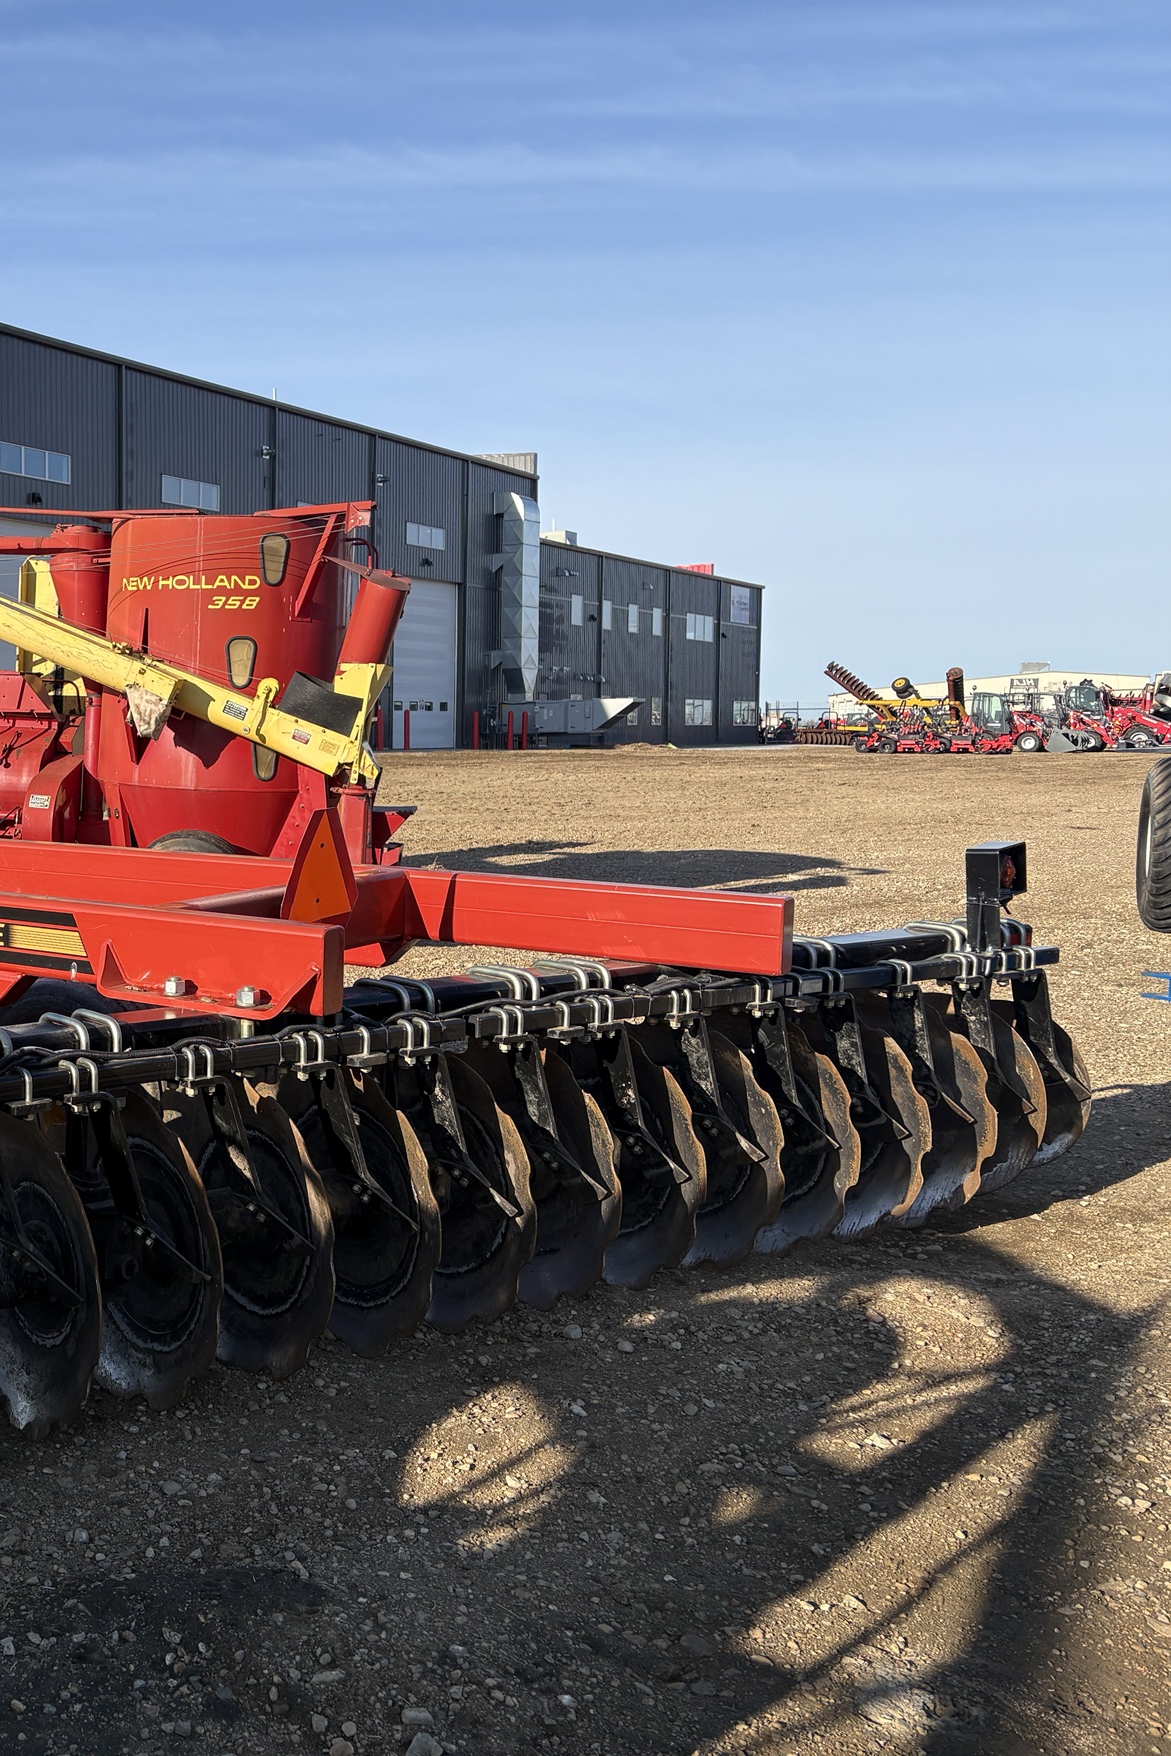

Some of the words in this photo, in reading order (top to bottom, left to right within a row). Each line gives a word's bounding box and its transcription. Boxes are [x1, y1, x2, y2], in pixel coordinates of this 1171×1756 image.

[122, 576, 155, 591] NEW
[158, 575, 261, 590] HOLLAND
[207, 596, 261, 609] 358
